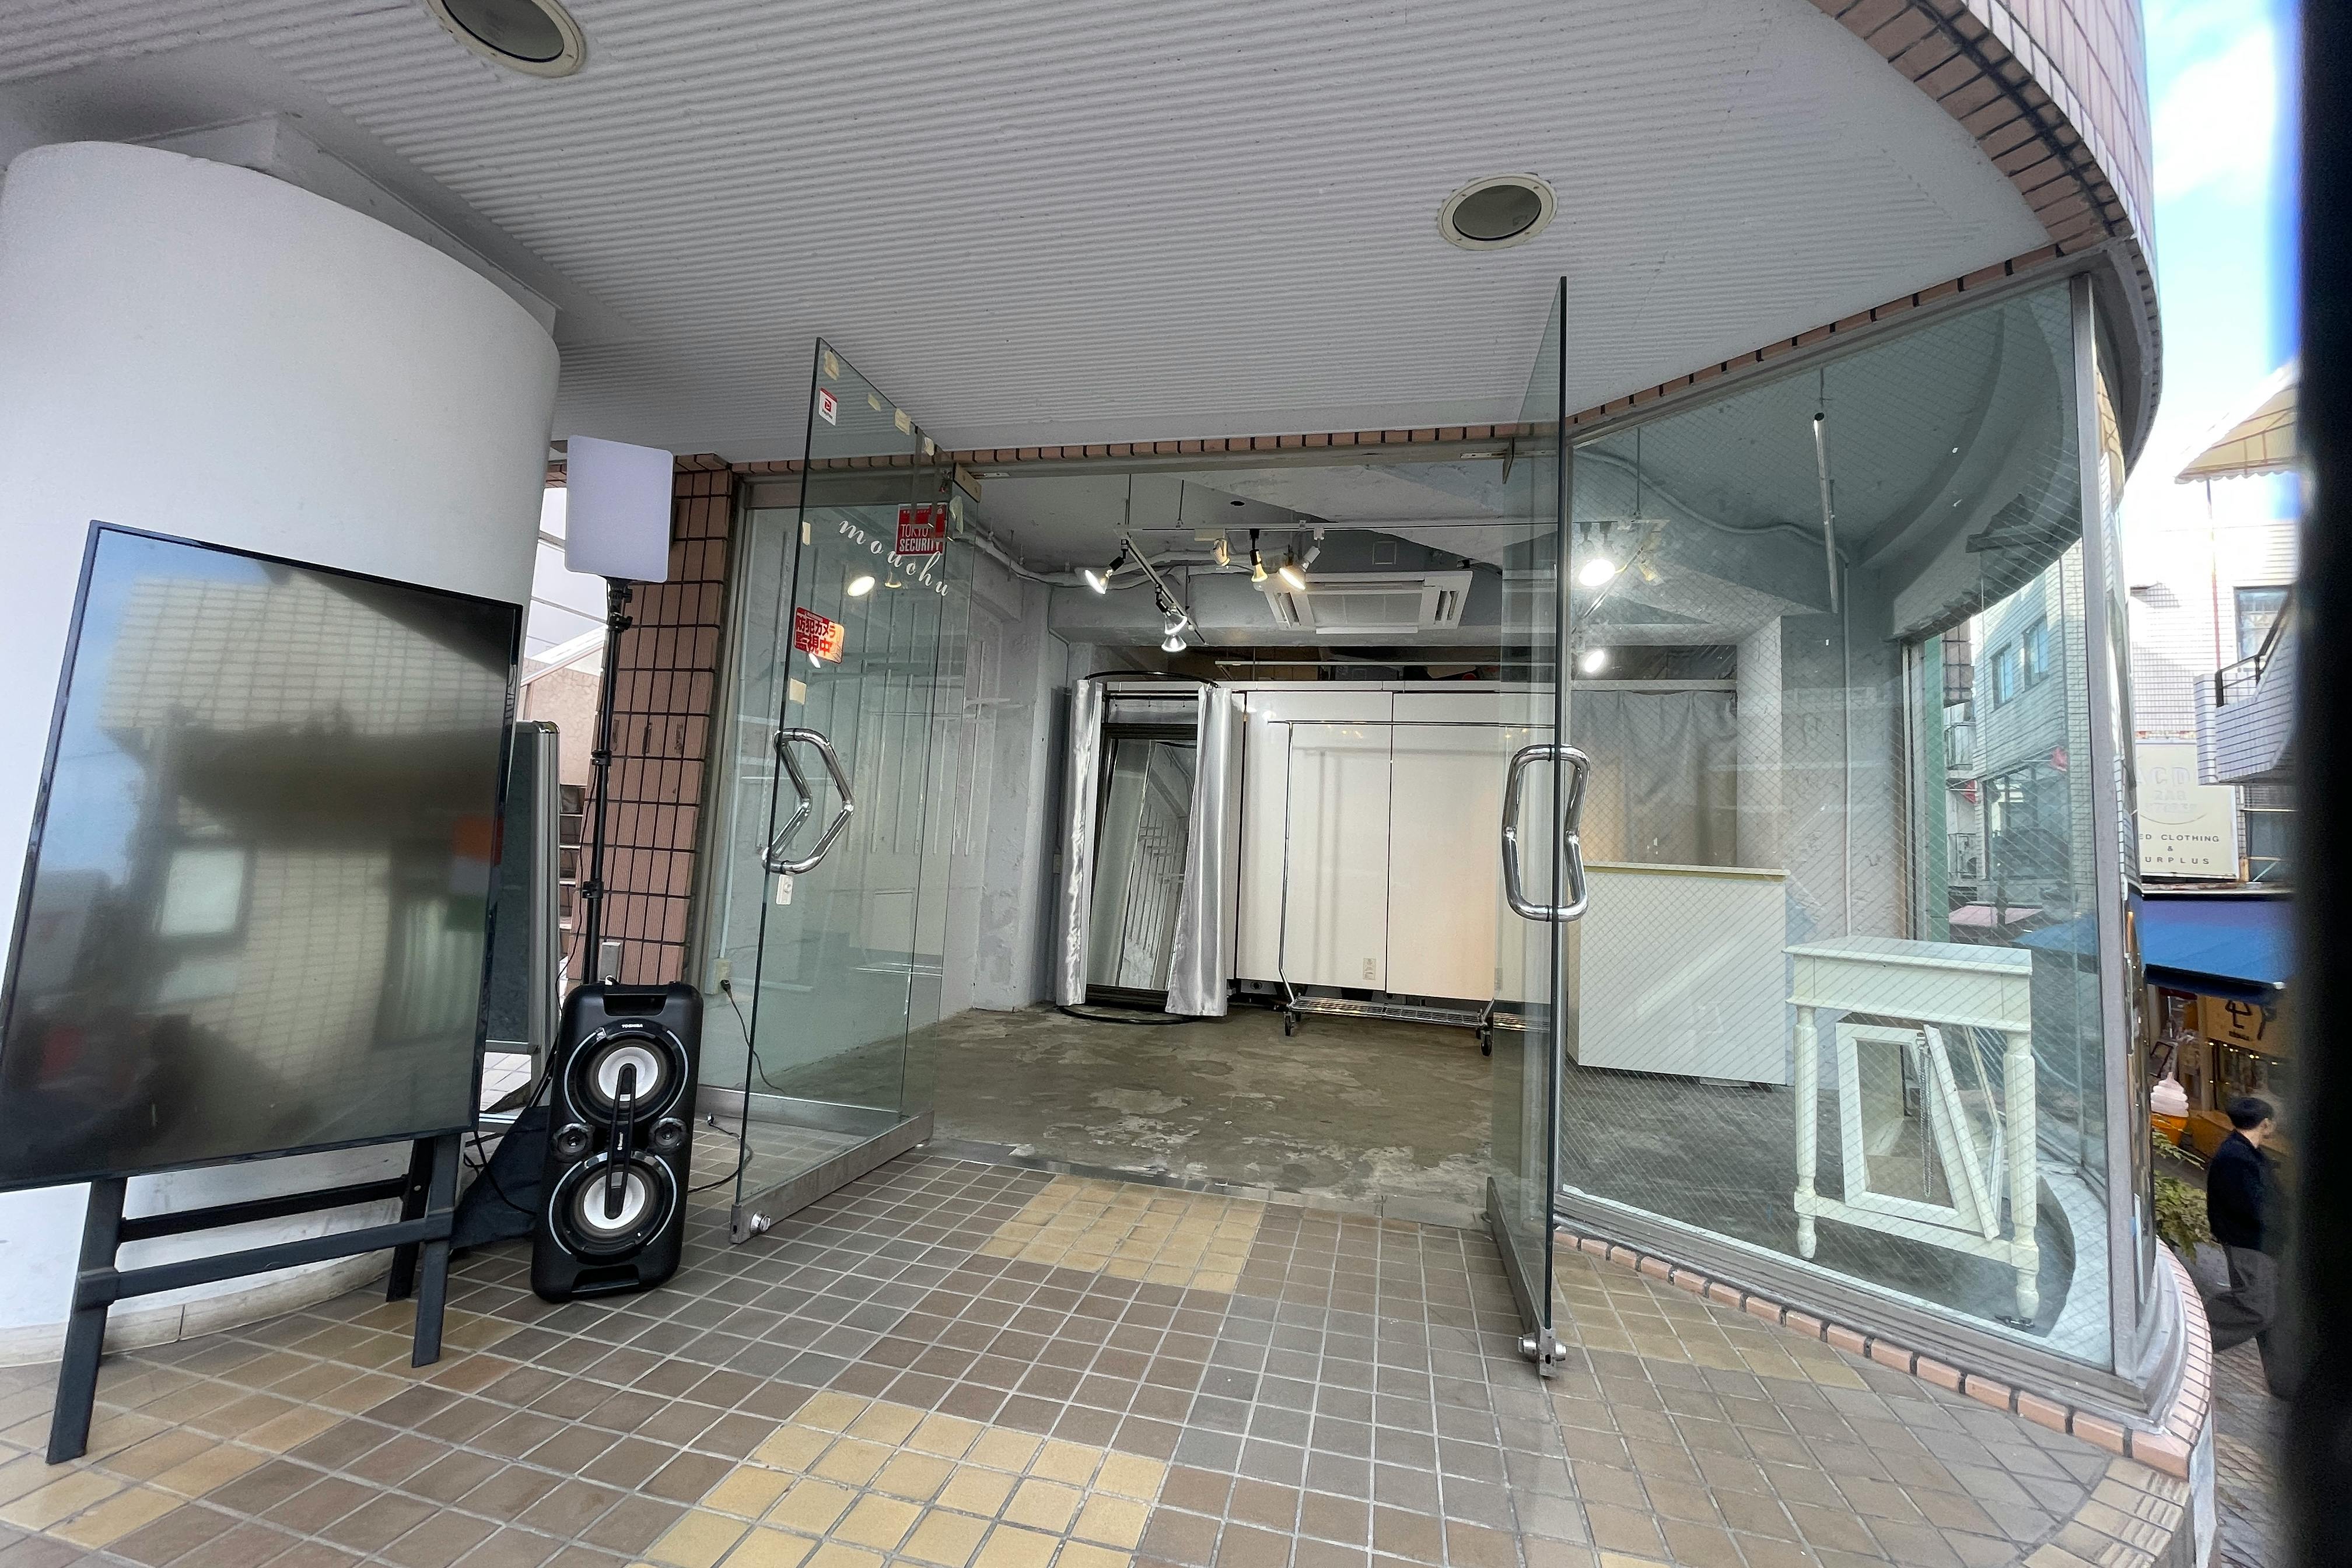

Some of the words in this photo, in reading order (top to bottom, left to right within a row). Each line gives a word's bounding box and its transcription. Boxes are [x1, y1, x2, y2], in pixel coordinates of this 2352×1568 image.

[901, 524, 928, 537] TOKYO
[899, 538, 940, 552] SECURITY
[2161, 834, 2219, 842] CLOTHING
[2145, 856, 2209, 864] URPLUS
